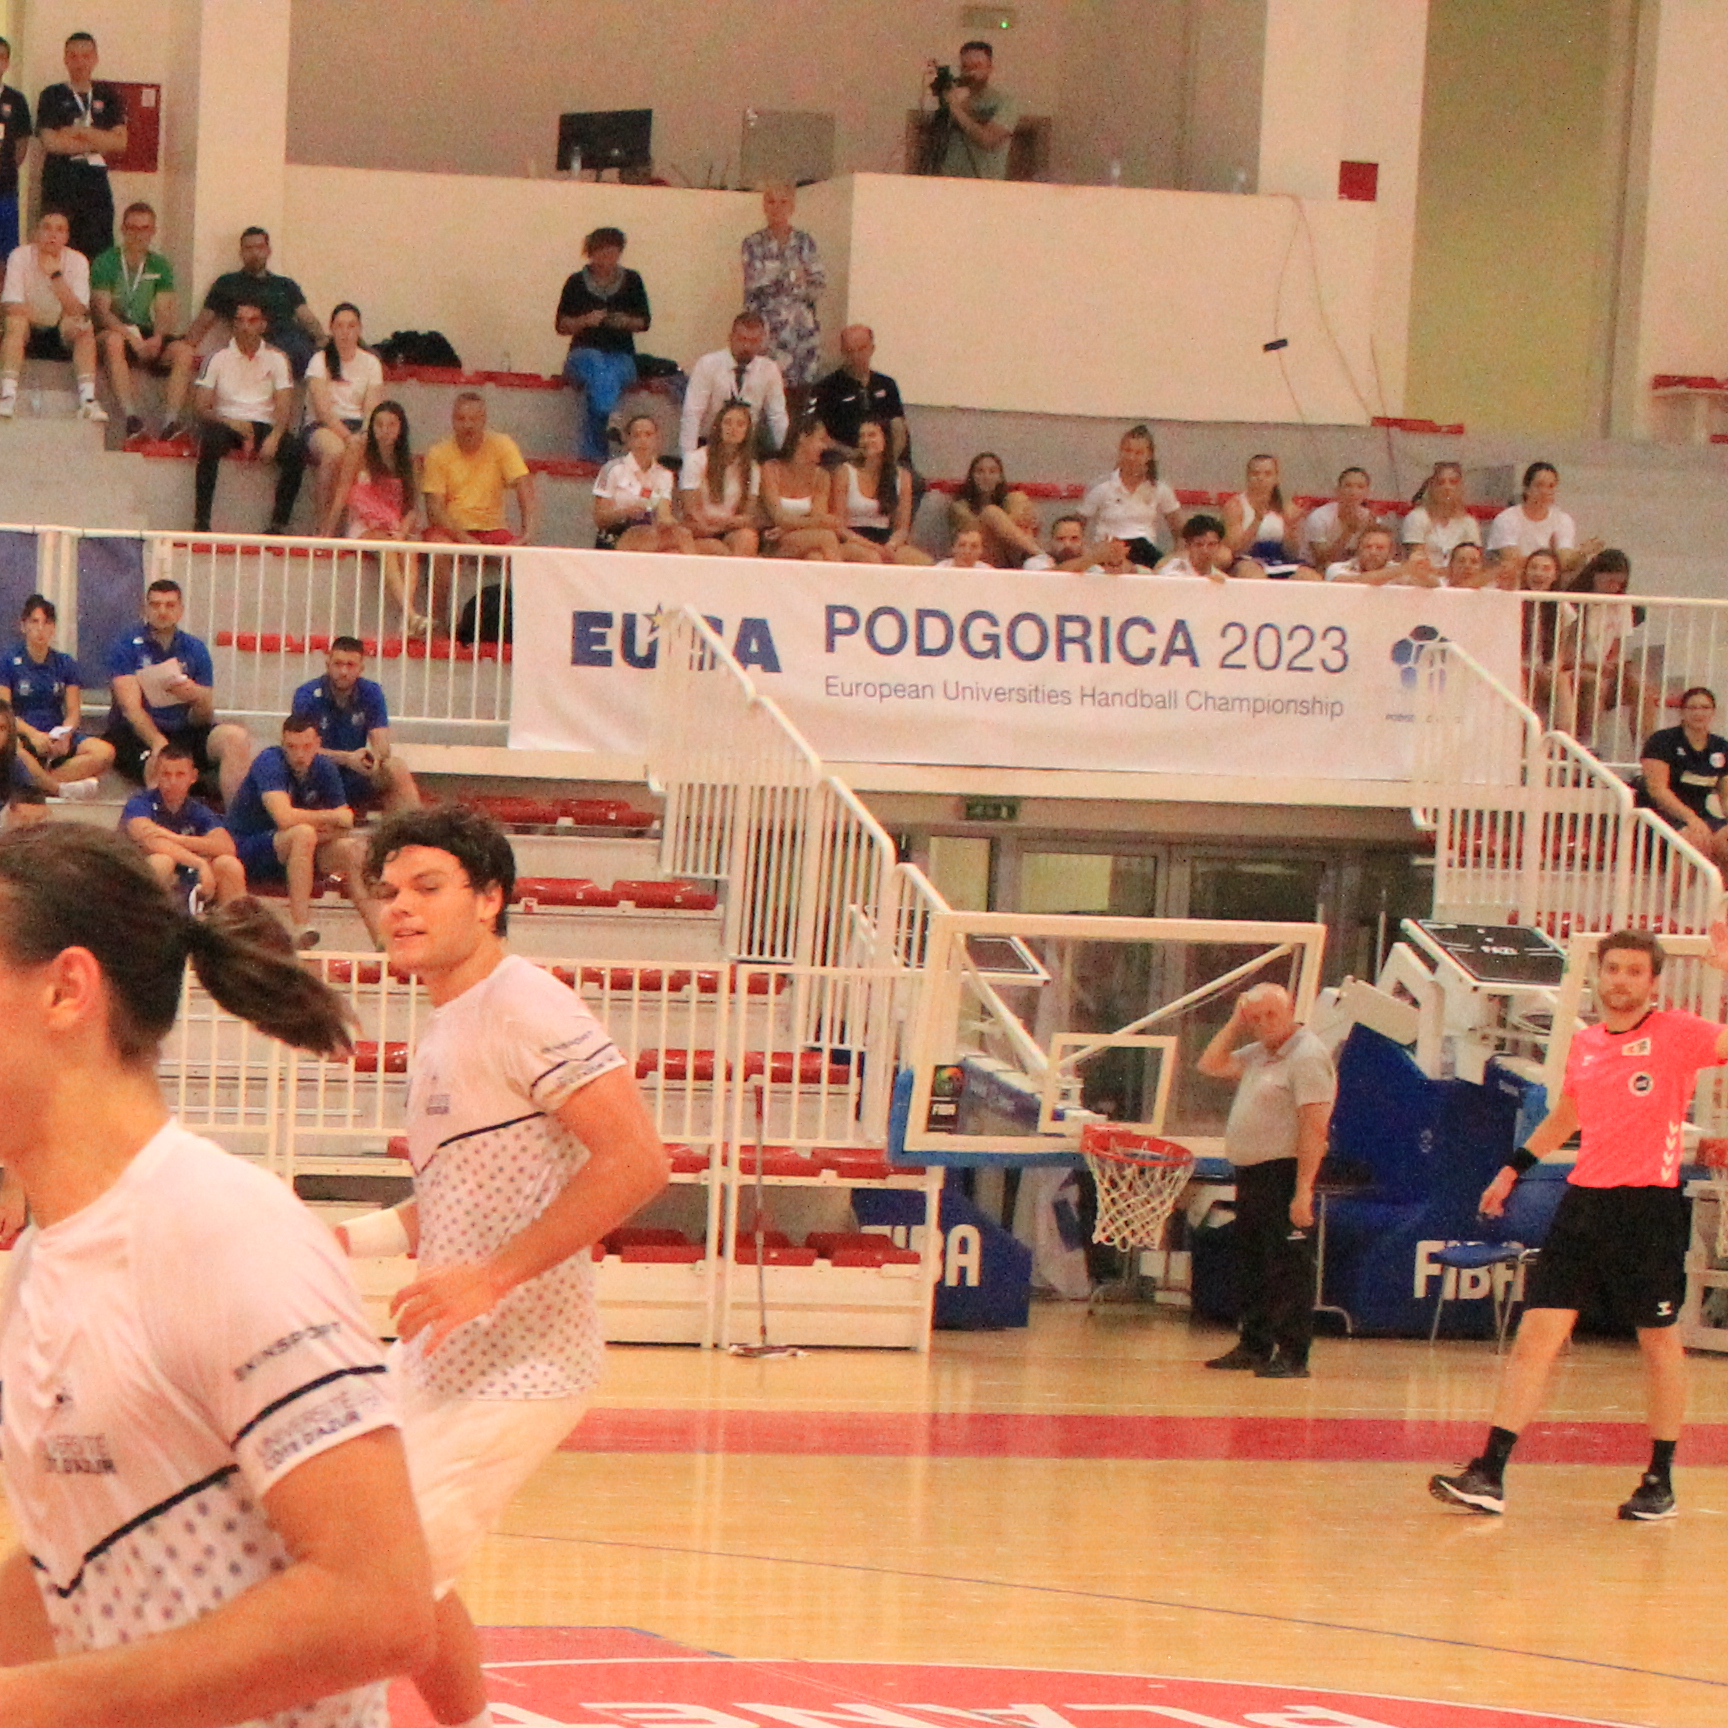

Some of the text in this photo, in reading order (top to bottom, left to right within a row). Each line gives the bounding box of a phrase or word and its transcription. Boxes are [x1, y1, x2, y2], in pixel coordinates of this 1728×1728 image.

[570, 609, 782, 674] EUA
[824, 604, 1349, 674] PODGORICA 2023
[824, 675, 1345, 721] European Universities Handball Championship
